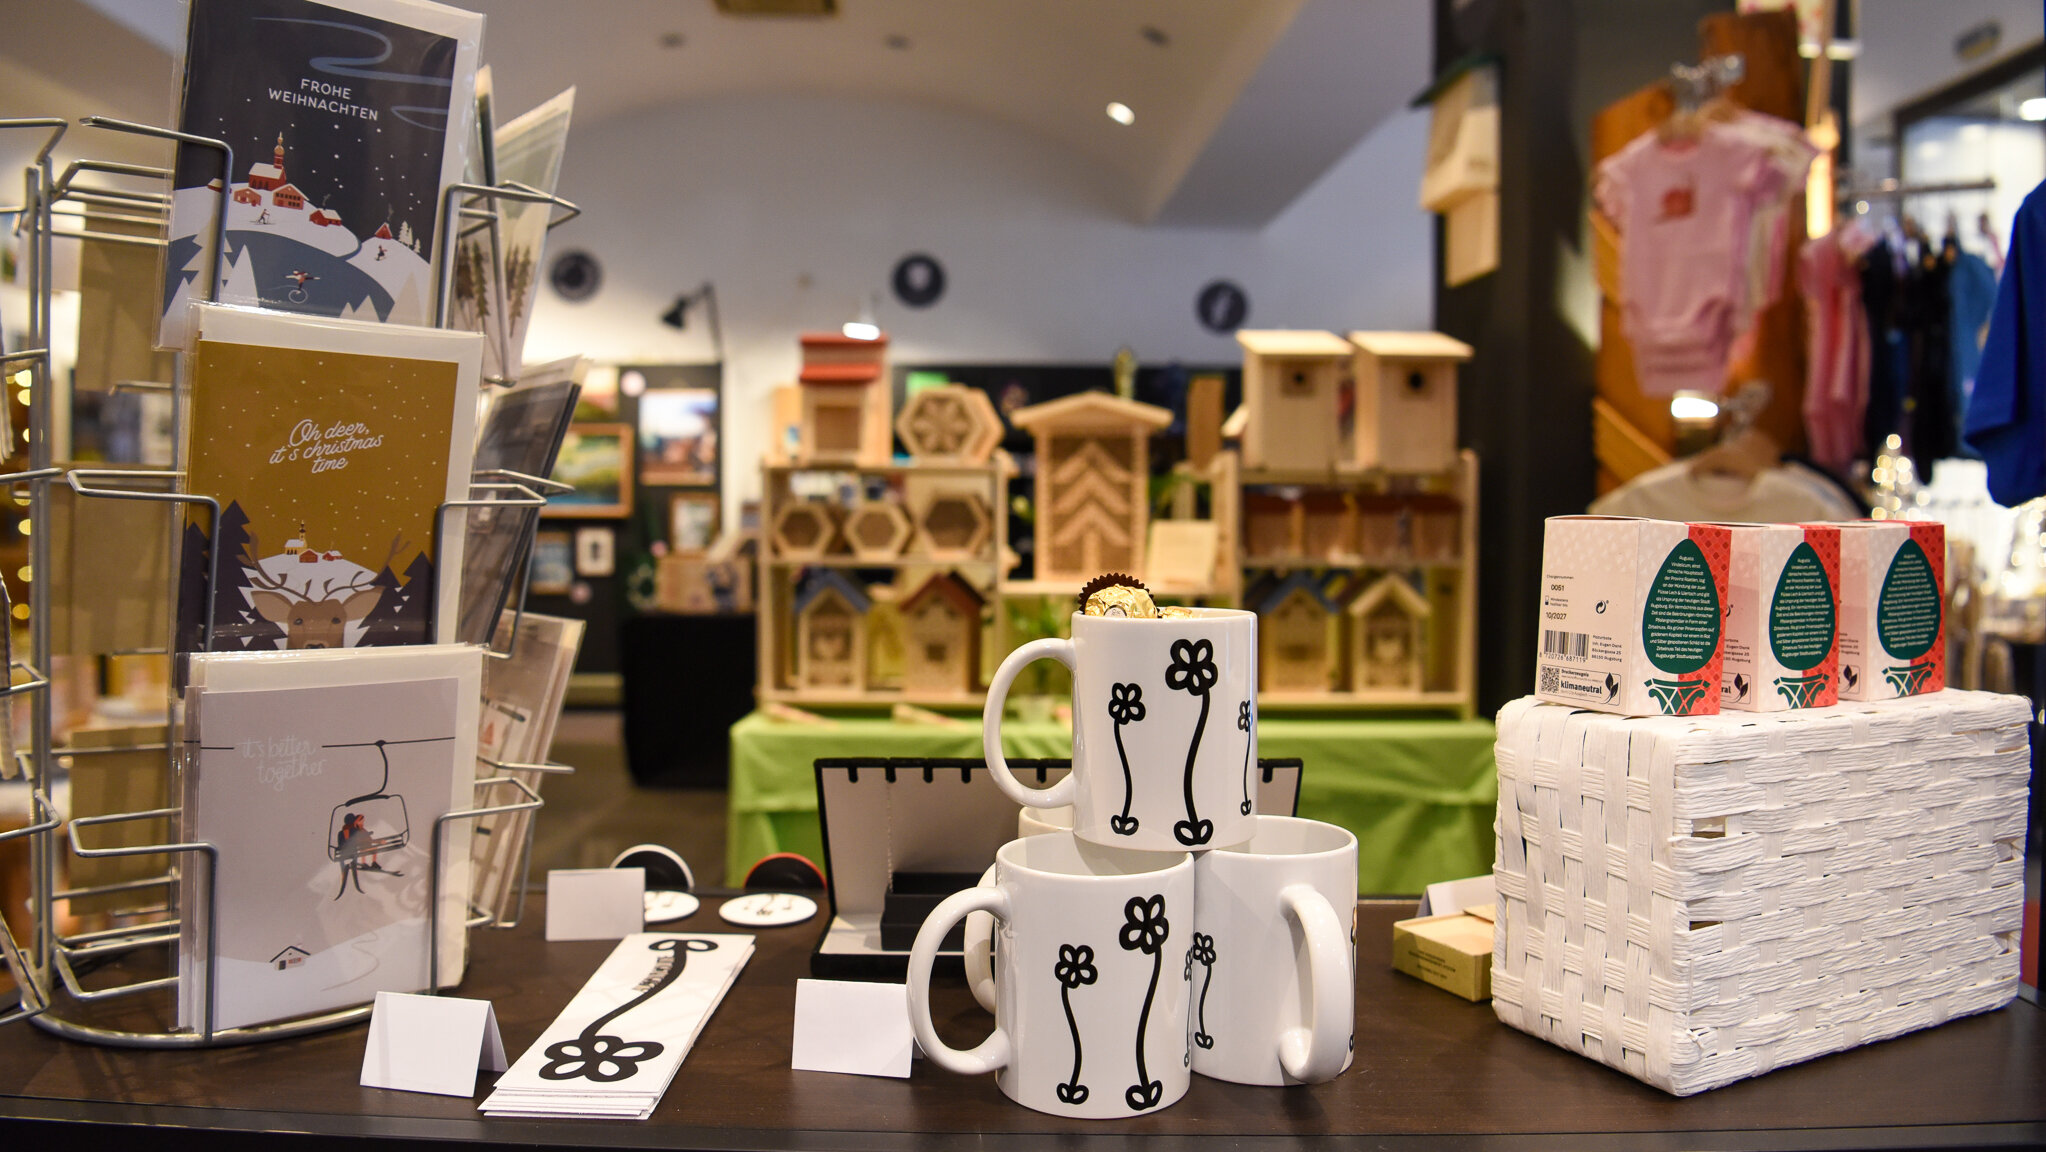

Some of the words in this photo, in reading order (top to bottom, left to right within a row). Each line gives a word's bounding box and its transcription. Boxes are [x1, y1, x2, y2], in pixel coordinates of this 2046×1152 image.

[301, 78, 352, 100] FROHE
[268, 87, 378, 121] WEIHNACHTEN
[289, 419, 321, 447] Oh
[324, 421, 370, 439] deer,
[269, 445, 299, 464] it's
[303, 434, 384, 459] christmas
[311, 456, 348, 474] time
[1546, 611, 1567, 620] 10/2027
[1560, 680, 1602, 694] klimaneutral
[256, 753, 328, 792] together
